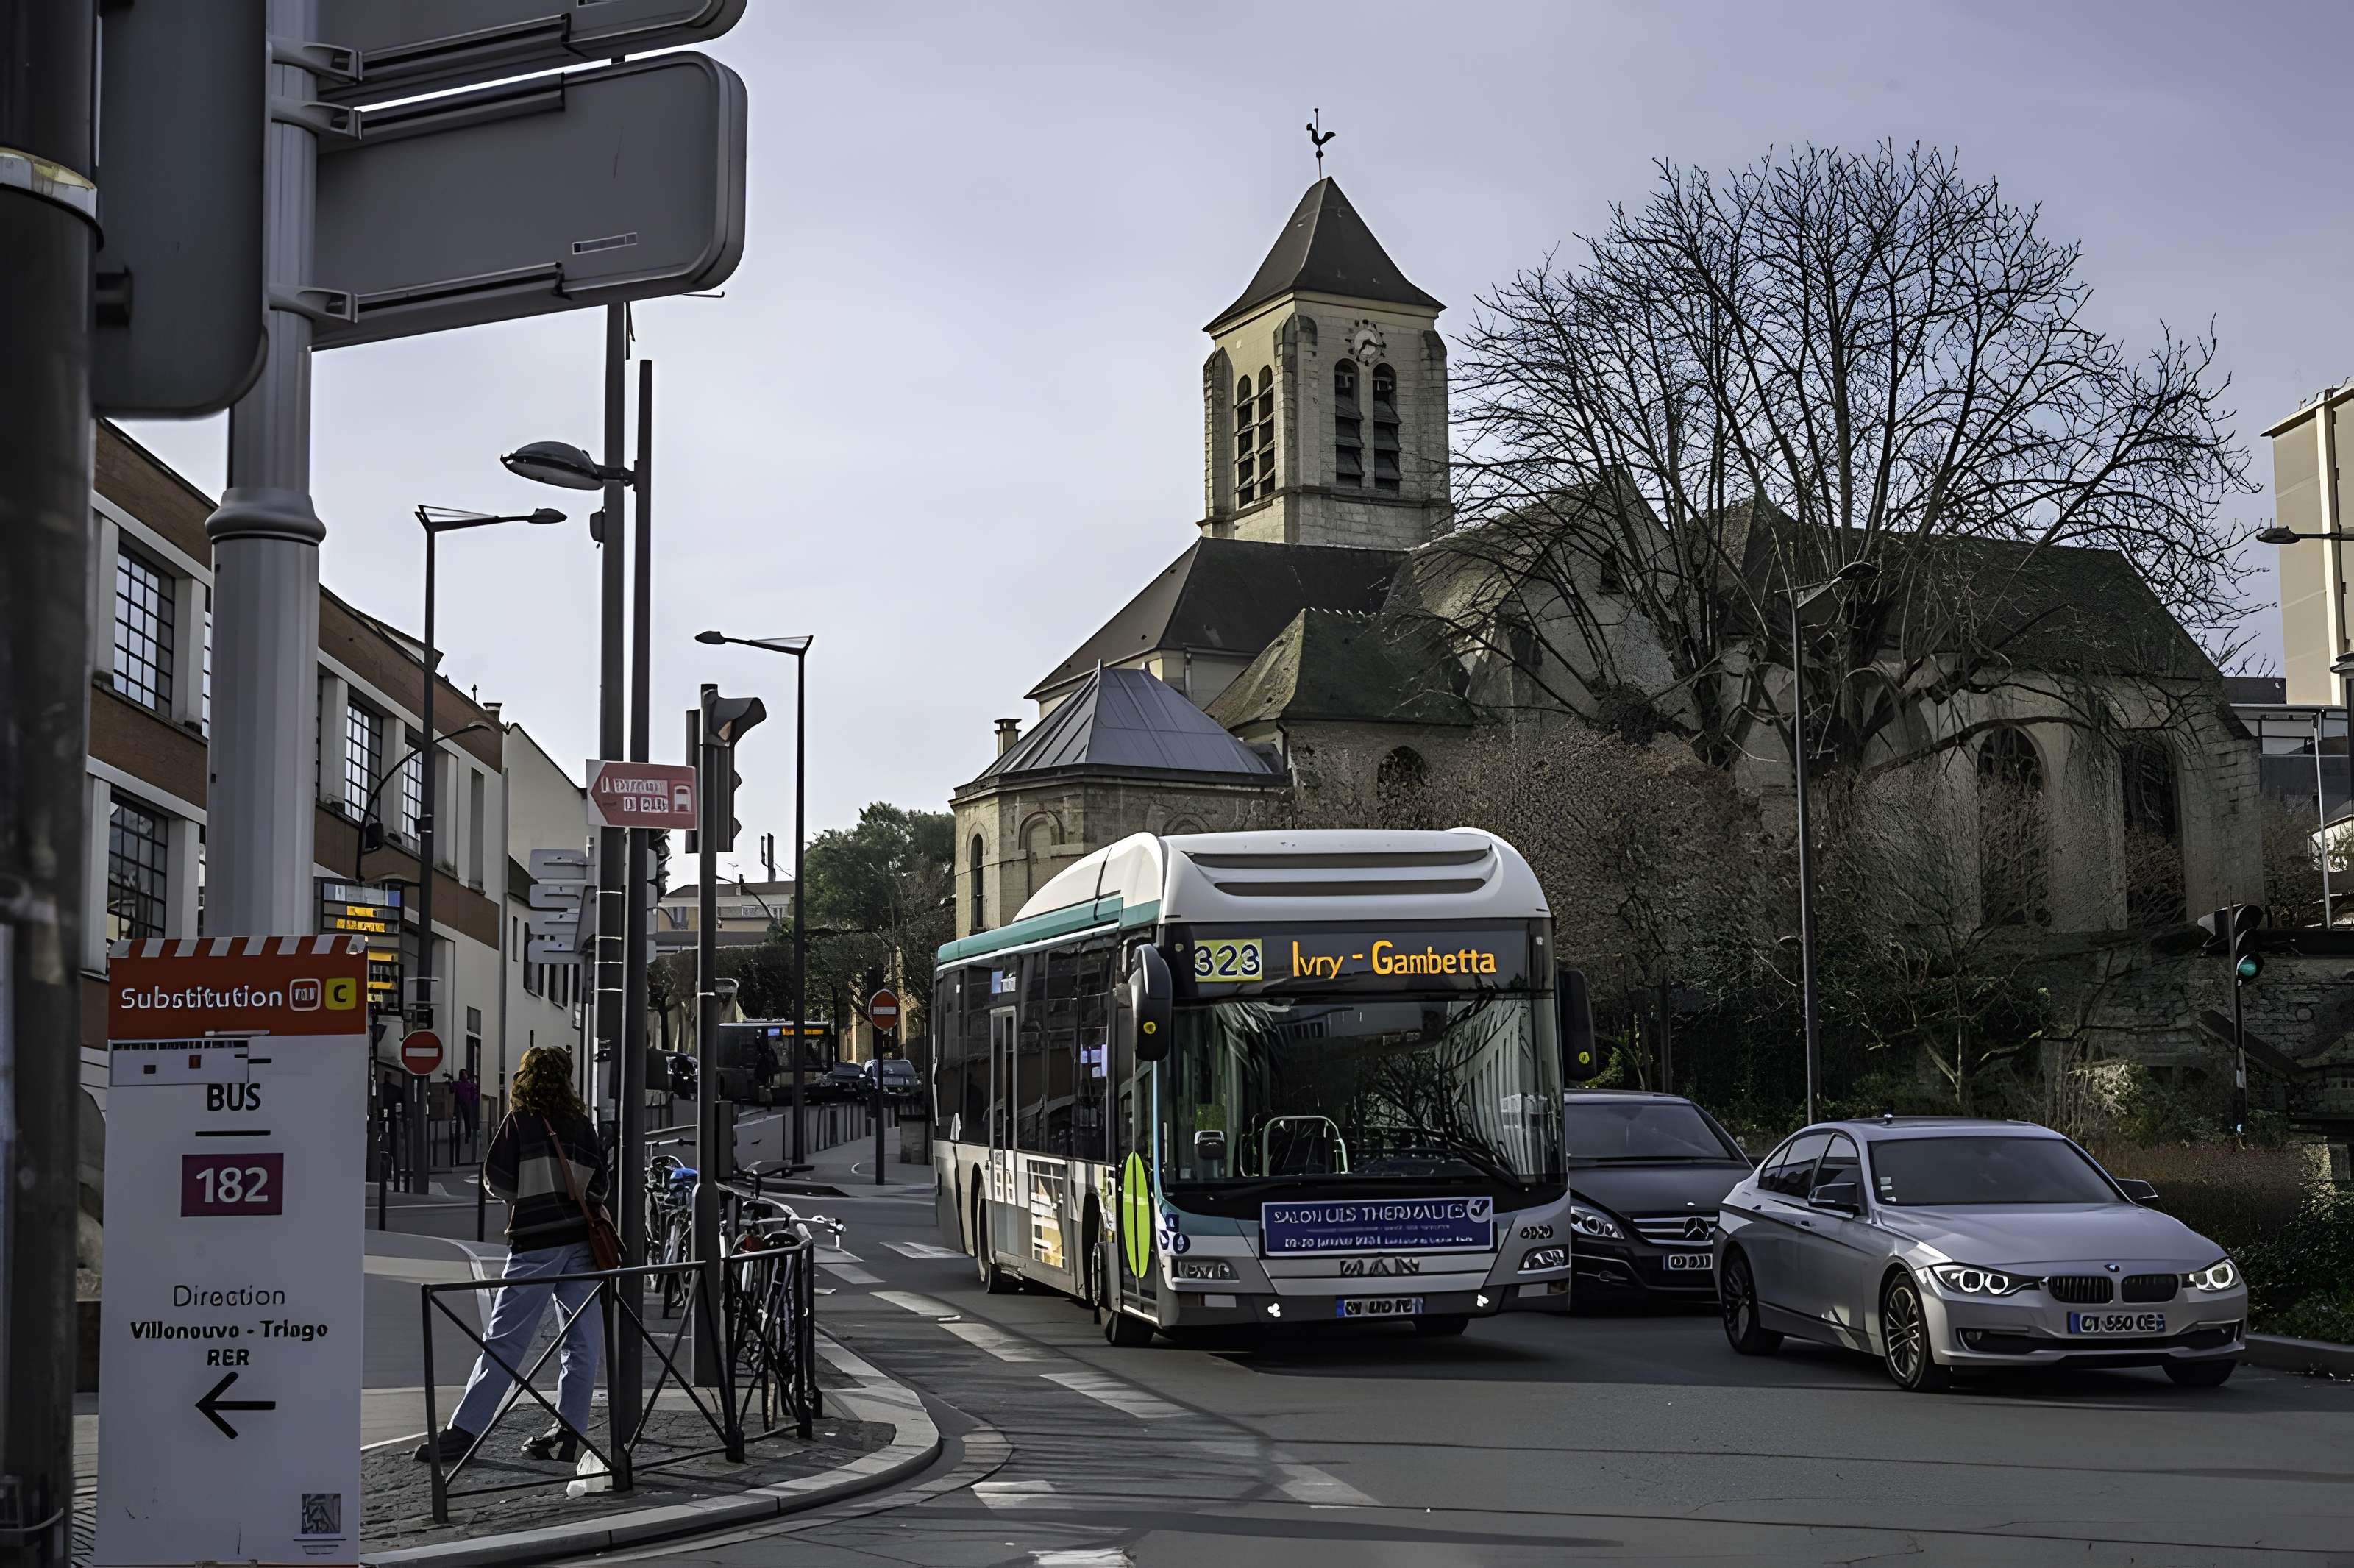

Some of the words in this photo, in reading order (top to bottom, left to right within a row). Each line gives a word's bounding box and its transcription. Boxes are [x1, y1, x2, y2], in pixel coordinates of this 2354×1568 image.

[1195, 944, 1260, 977] 323
[1292, 941, 1344, 980] Ivry
[1371, 940, 1496, 975] Gambetta
[121, 985, 282, 1009] Substitution
[333, 984, 347, 1003] C
[207, 1083, 261, 1111] BUS
[196, 1166, 269, 1203] 182
[173, 1285, 285, 1307] Direction
[207, 1348, 250, 1366] RER
